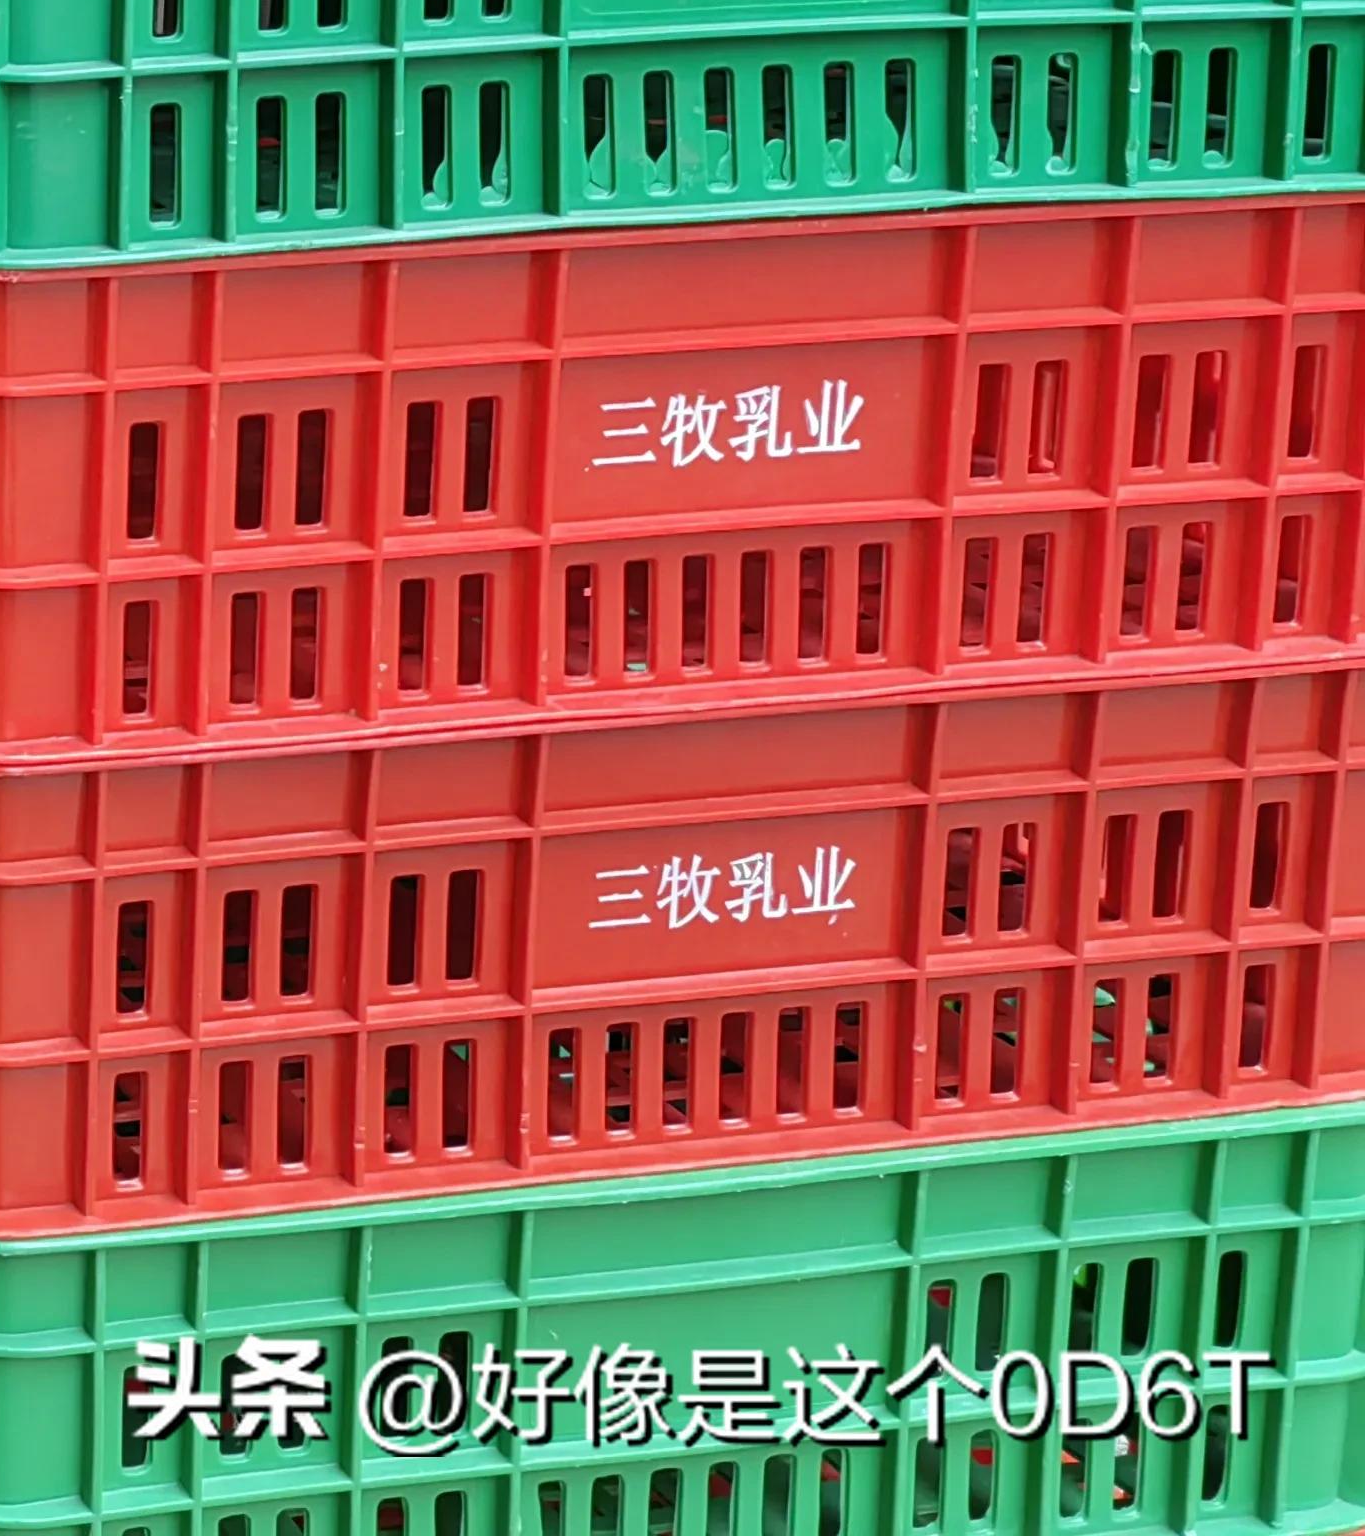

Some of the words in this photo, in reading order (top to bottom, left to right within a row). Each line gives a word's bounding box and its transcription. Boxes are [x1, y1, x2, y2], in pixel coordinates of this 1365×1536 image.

[591, 378, 865, 469] 三牧乳业
[587, 844, 858, 930] 三牧乳业
